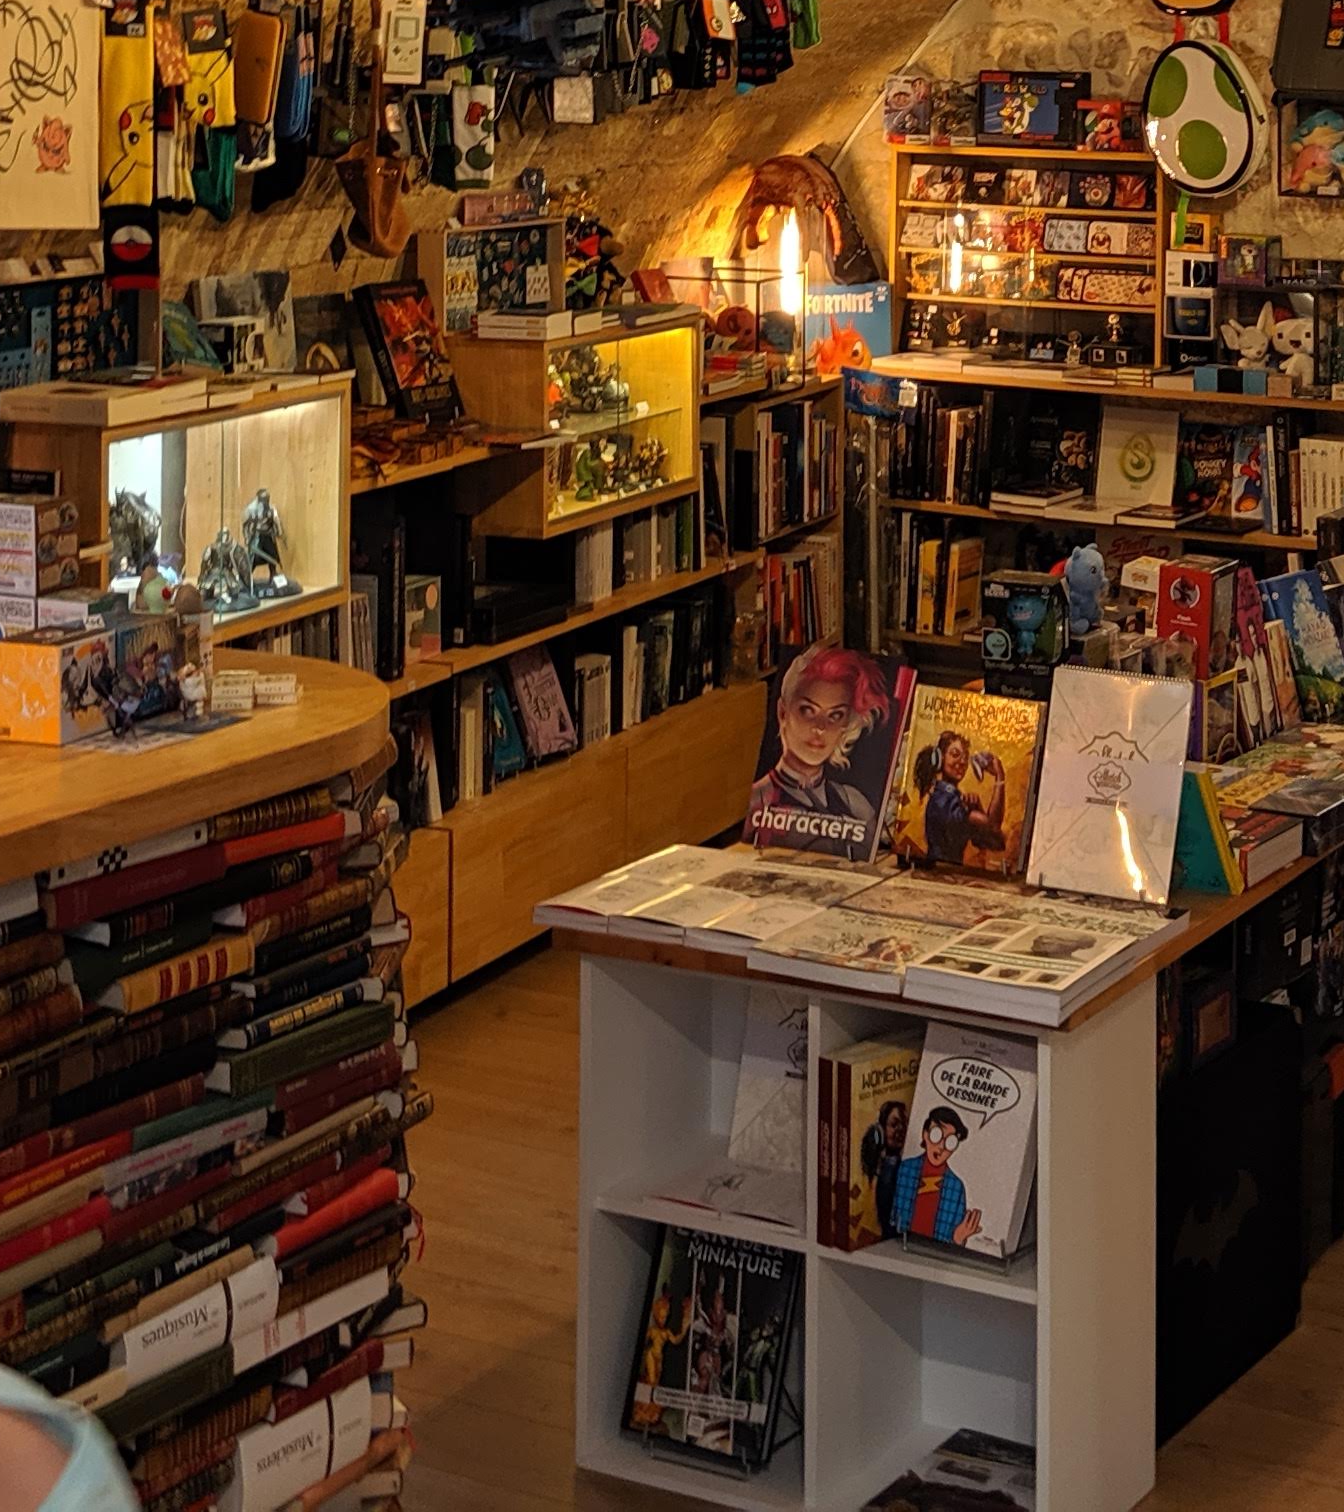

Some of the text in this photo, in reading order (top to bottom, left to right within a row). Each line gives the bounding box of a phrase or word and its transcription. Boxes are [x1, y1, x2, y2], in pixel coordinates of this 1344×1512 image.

[805, 291, 874, 317] FORTNITE
[752, 805, 867, 843] characters
[862, 1063, 902, 1089] WOMEN
[940, 1070, 1010, 1098] DE LA BANDE
[960, 1062, 994, 1080] FAIRE
[946, 1086, 999, 1109] DESSINÉE
[687, 1240, 784, 1280] MINIATURE
[141, 1304, 209, 1349] Musiques
[256, 1432, 316, 1474] Musiciens
